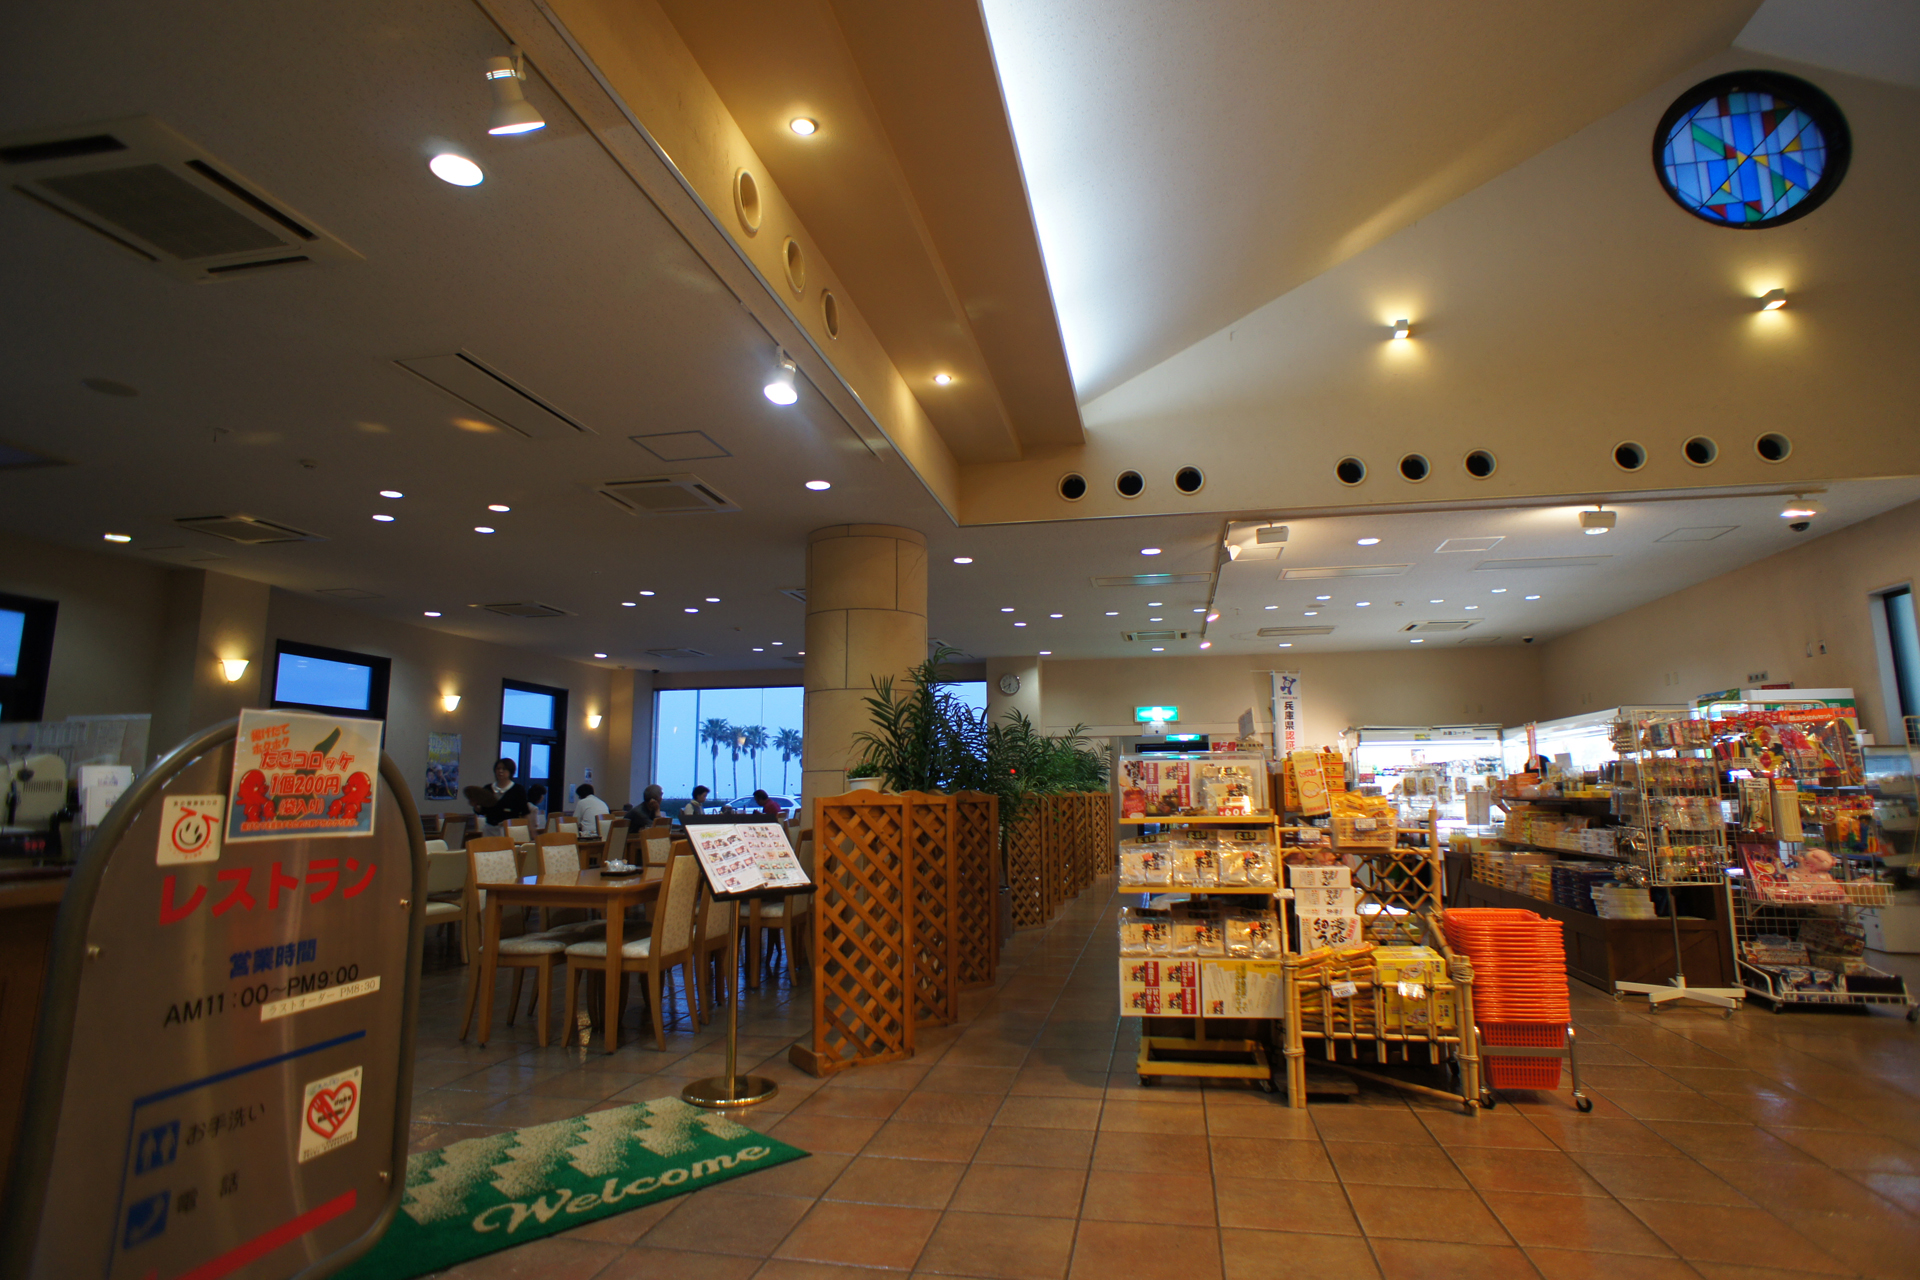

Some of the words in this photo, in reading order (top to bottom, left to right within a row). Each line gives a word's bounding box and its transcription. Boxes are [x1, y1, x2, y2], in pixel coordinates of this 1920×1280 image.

[259, 750, 355, 772] たこコロッケ
[269, 773, 342, 796] 1個200円
[159, 857, 378, 926] レストラン
[230, 938, 317, 979] 営業時間
[268, 992, 335, 1016] ラストオーダー
[339, 980, 376, 998] PM8:30
[186, 1103, 265, 1146] お手洗い
[472, 1146, 771, 1234] Welcome
